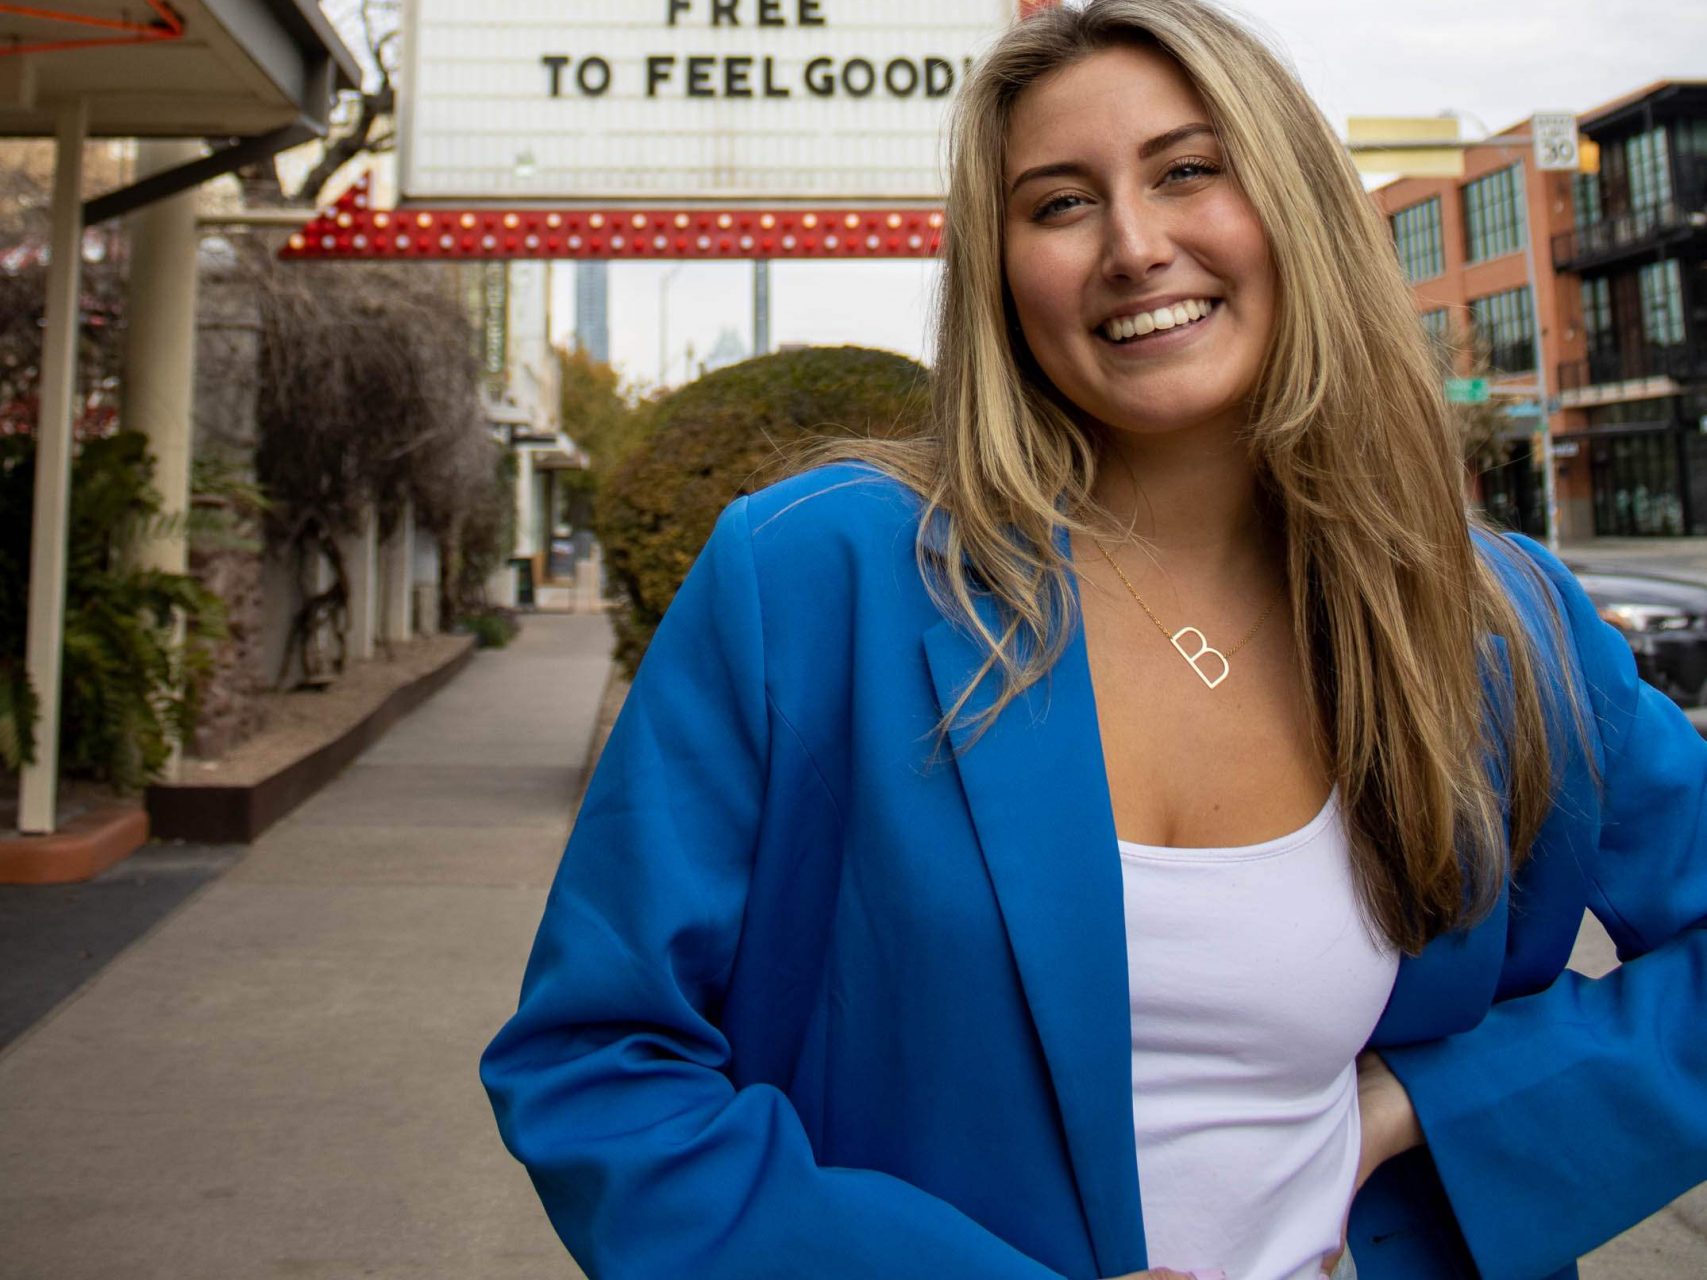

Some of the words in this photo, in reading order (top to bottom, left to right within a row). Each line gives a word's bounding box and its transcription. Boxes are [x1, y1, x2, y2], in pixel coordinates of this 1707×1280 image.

[542, 56, 611, 98] TO
[804, 57, 972, 99] GOOD
[1540, 139, 1574, 164] 30
[1170, 626, 1230, 689] B
